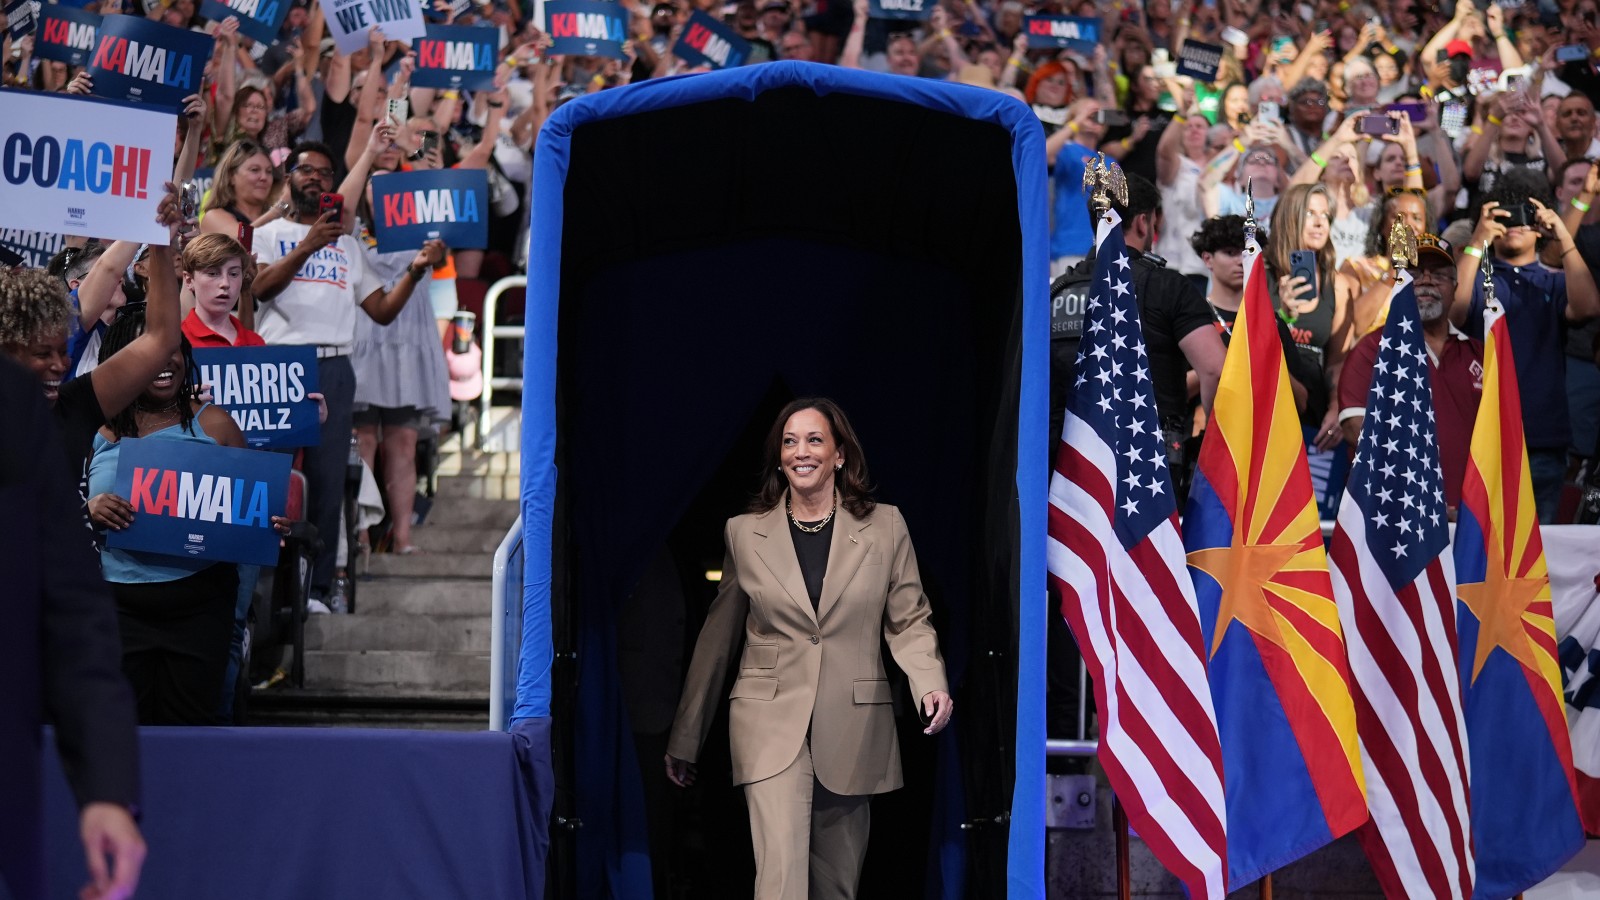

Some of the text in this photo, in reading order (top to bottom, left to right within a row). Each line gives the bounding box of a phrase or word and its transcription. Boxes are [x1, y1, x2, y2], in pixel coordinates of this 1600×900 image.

[335, 0, 412, 35] WE WIN
[552, 12, 624, 43] KAMALA
[1029, 20, 1097, 43] KAMALA
[92, 35, 192, 90] KAMALA
[420, 40, 492, 71] KAMALA
[3, 132, 151, 200] COACH!
[383, 188, 478, 227] KAMALA
[201, 361, 305, 406] HARRIS
[130, 467, 268, 528] KAMALA
